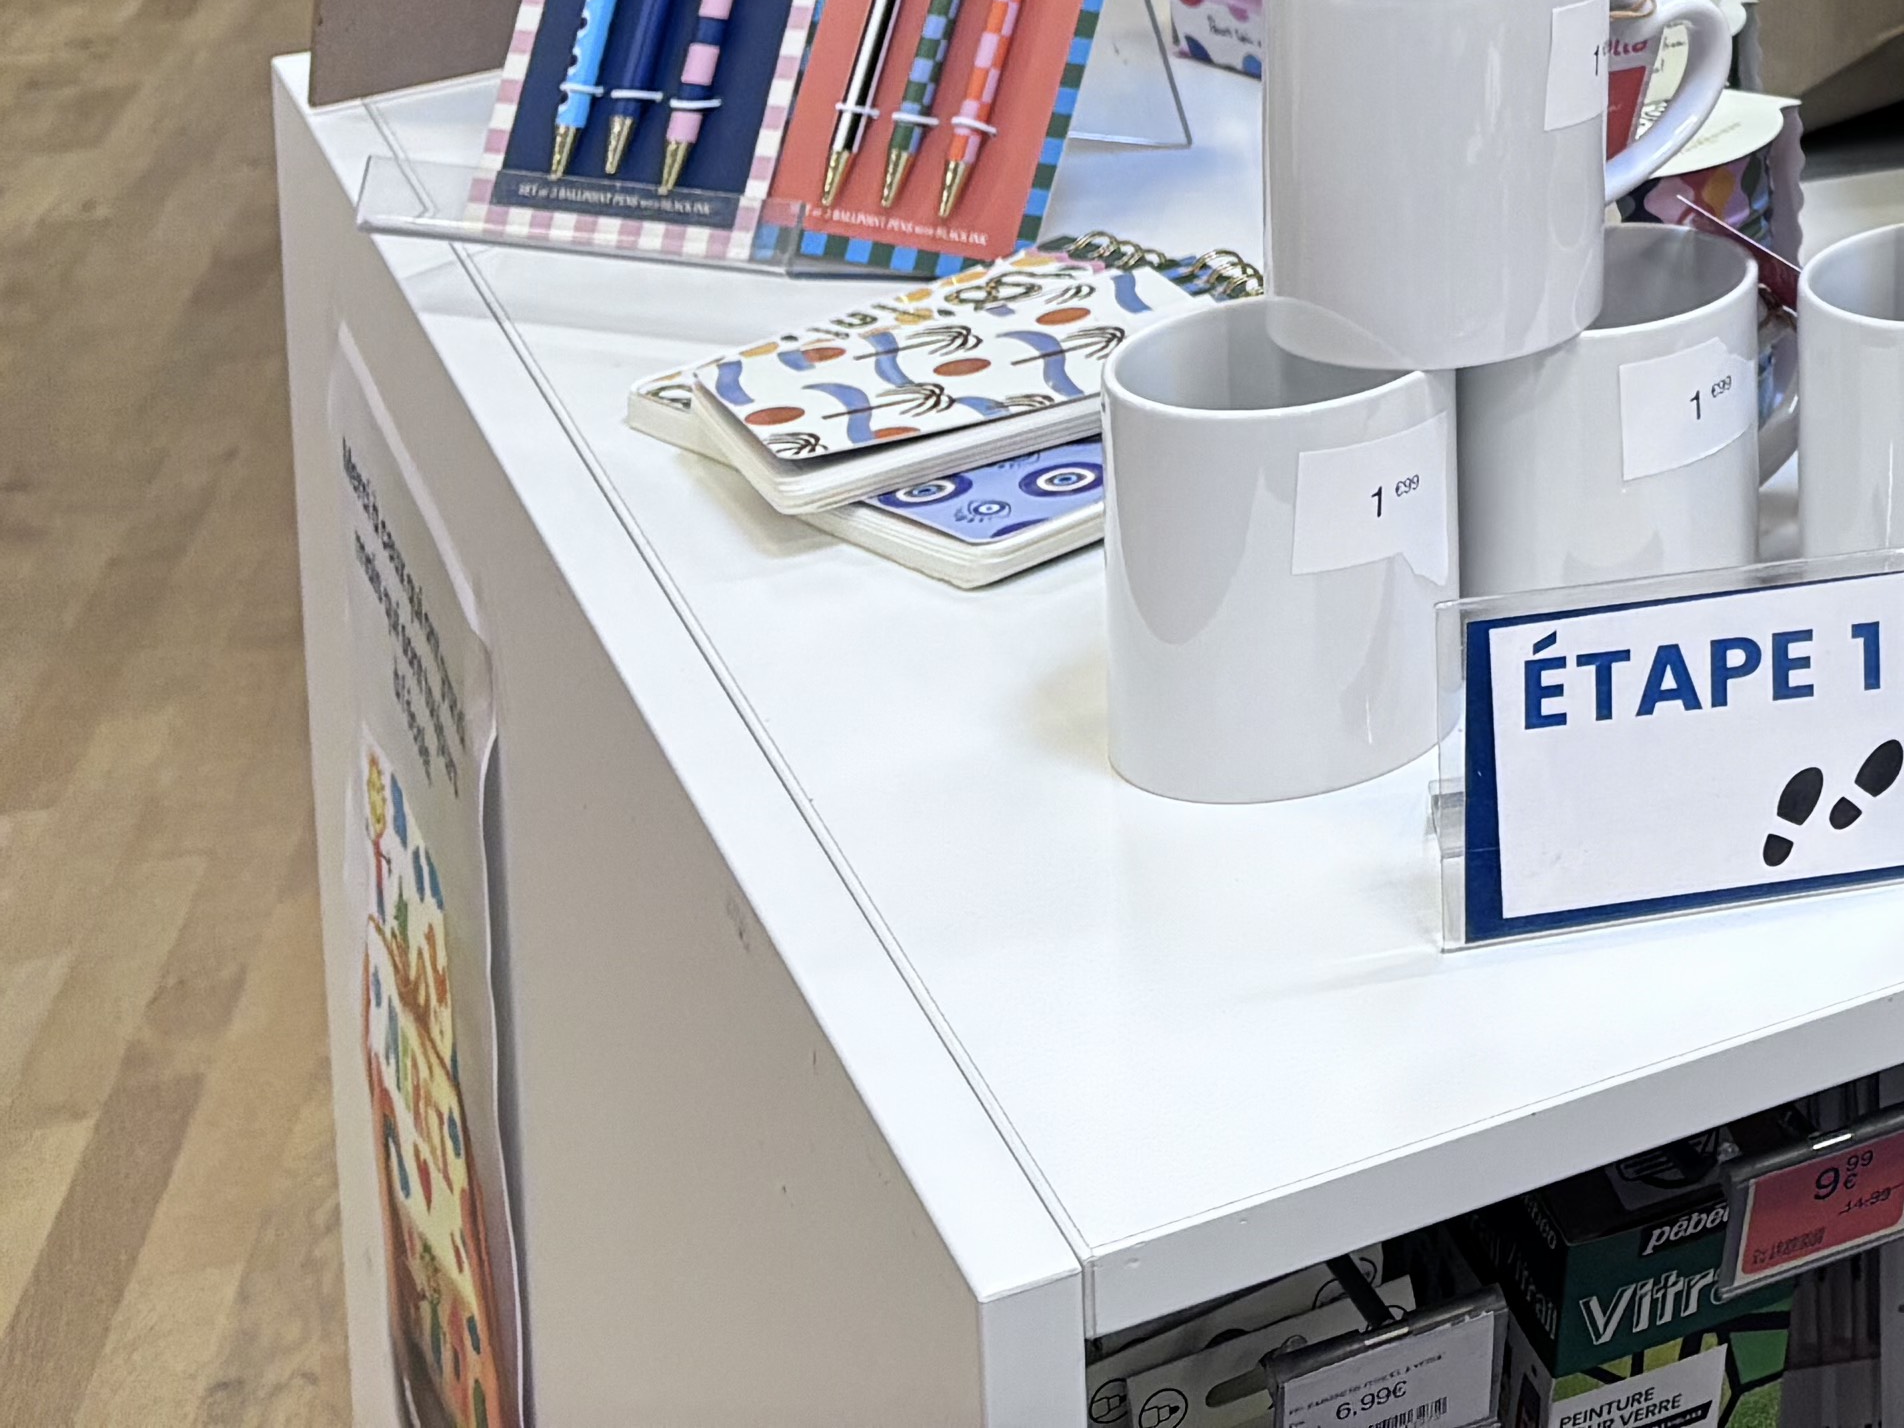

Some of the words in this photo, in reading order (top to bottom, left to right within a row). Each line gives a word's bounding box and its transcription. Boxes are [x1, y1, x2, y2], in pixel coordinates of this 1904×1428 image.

[1592, 44, 1601, 77] 1
[1690, 390, 1705, 421] 1
[1710, 374, 1733, 399] €99
[1371, 486, 1386, 519] 1
[1394, 473, 1421, 498] €99
[1522, 628, 1815, 731] ÉTAPE
[1851, 619, 1884, 691] 1
[1843, 1170, 1858, 1190] €
[1845, 1149, 1874, 1173] 99
[1814, 1167, 1841, 1202] 9
[1642, 1201, 1730, 1257] pébé
[1579, 1266, 1724, 1347] Vitr
[1559, 1387, 1657, 1428] PEINTURE
[1619, 1393, 1684, 1428] VERRE
